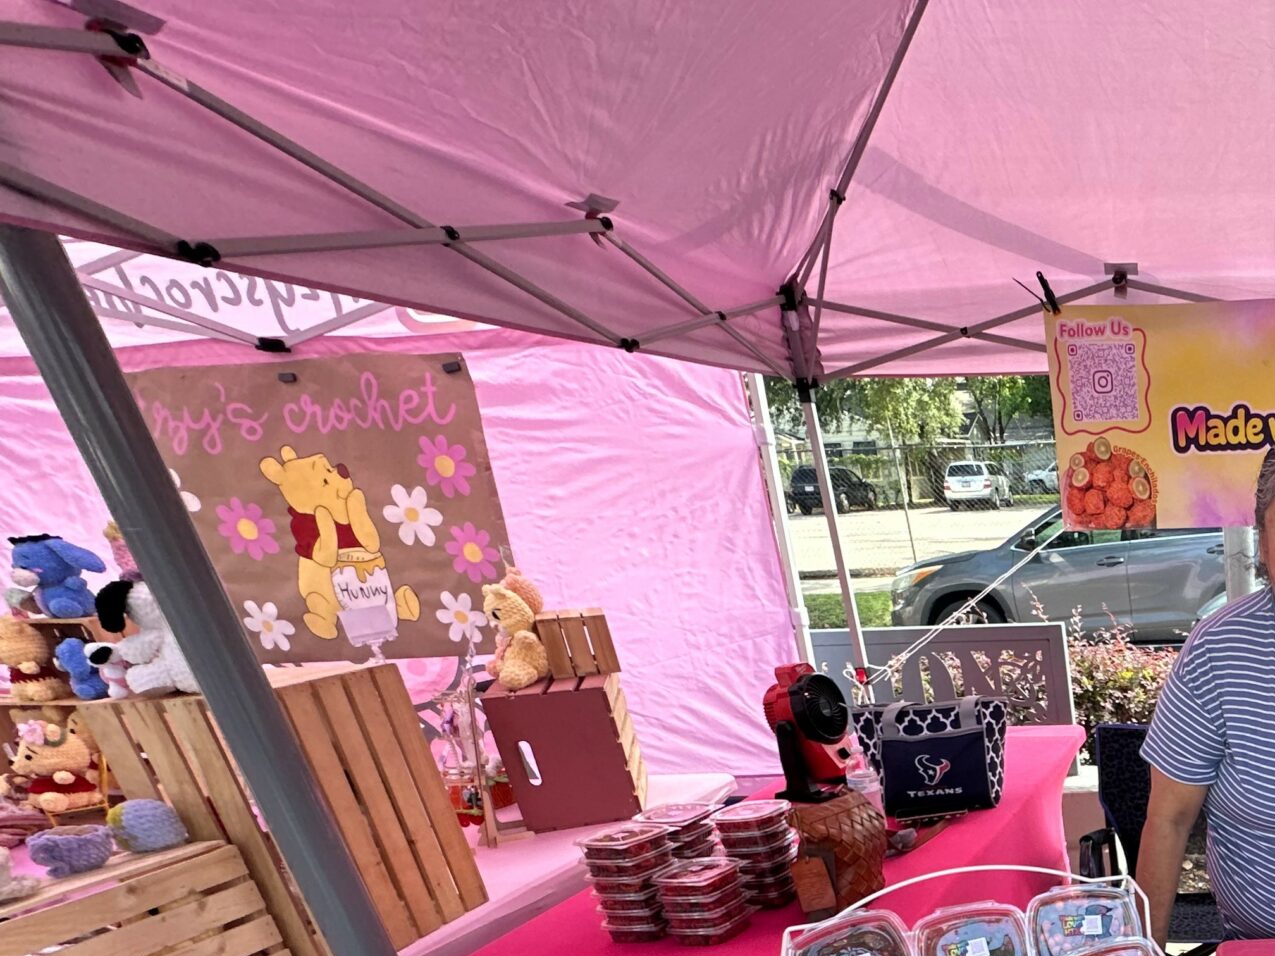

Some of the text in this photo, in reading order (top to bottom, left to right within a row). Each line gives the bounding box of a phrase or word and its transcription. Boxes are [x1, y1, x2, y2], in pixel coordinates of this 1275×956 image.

[1060, 320, 1129, 338] Follow Us
[283, 372, 456, 434] crochet
[1175, 407, 1265, 448] Made
[906, 786, 963, 799] TEXANS
